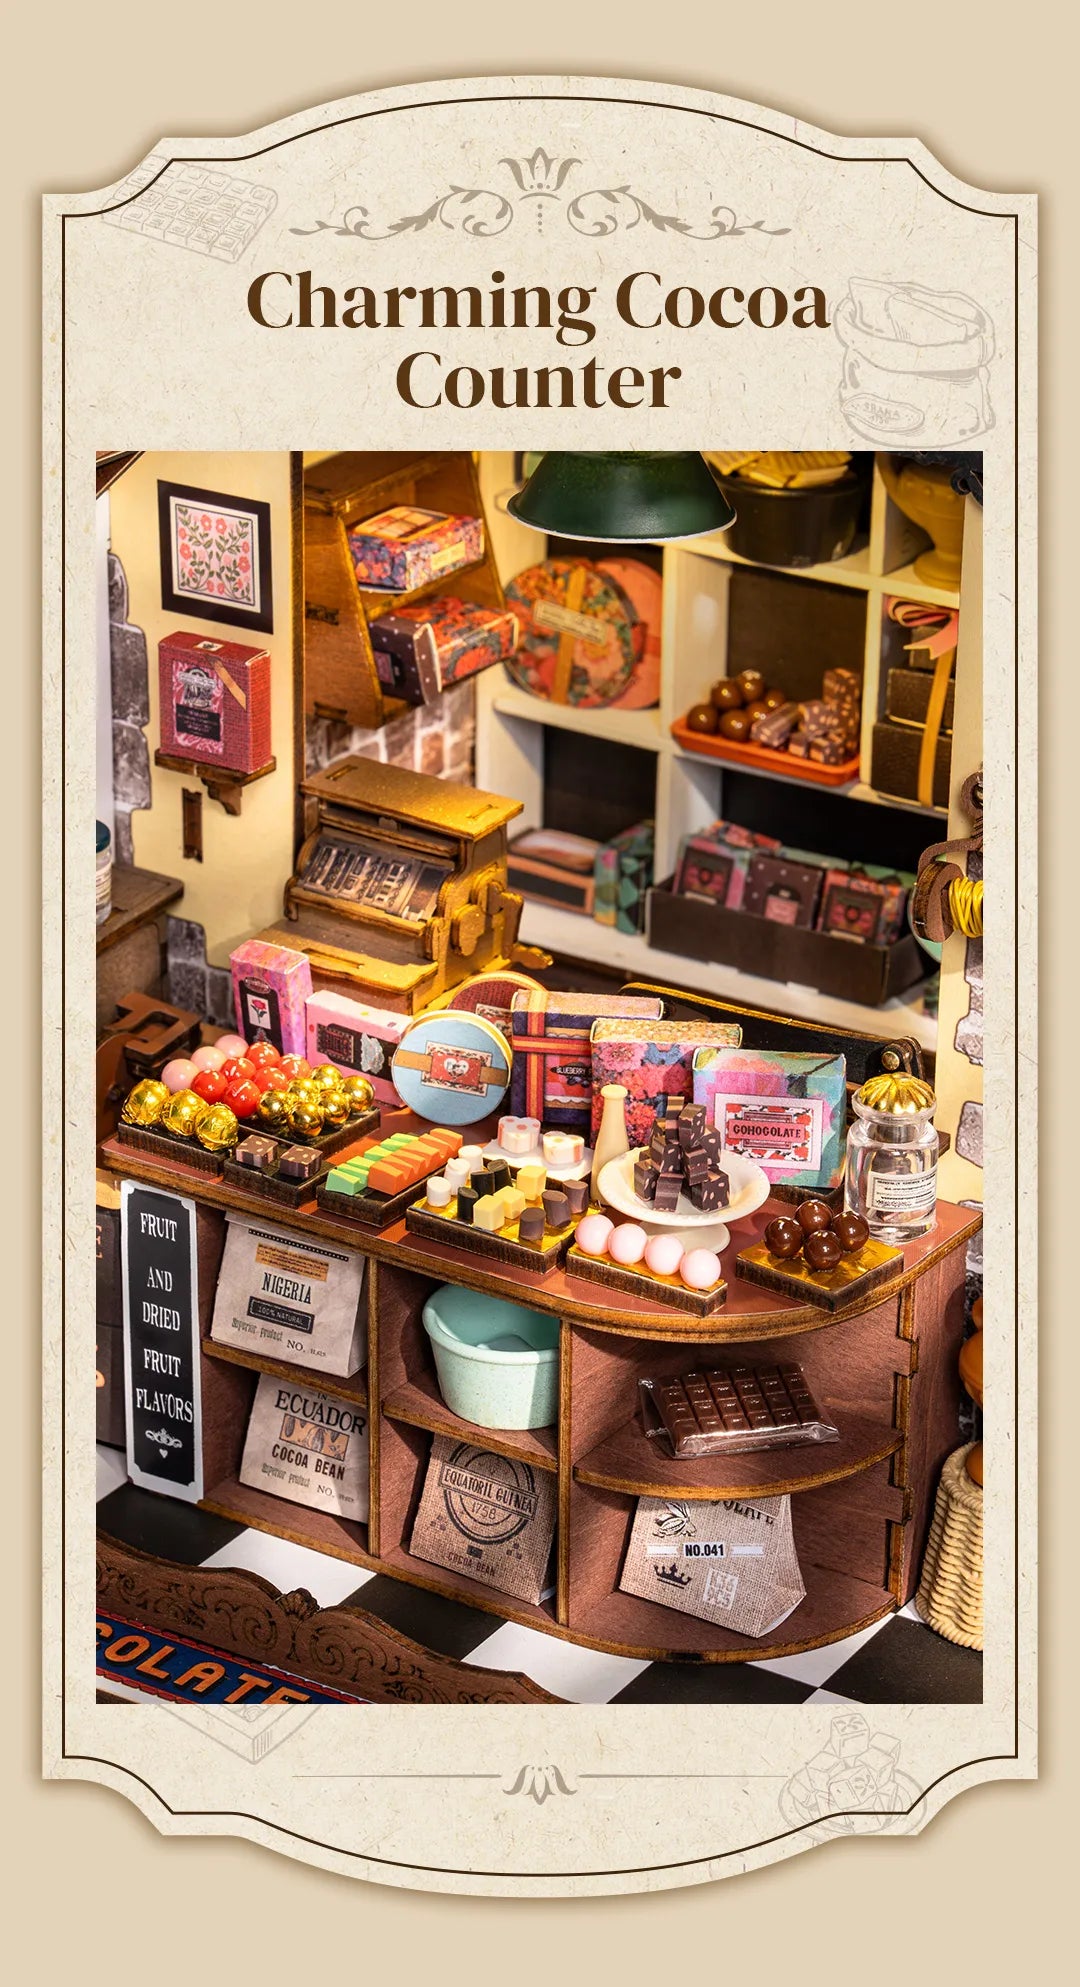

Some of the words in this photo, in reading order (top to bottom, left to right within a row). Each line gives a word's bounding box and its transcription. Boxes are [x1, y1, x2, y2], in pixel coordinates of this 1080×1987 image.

[140, 1212, 178, 1242] FRUIT
[147, 1266, 173, 1292] AND
[261, 1272, 312, 1304] NIGERIA
[142, 1301, 181, 1331] DRIED
[287, 1339, 306, 1354] NO.
[144, 1348, 182, 1378] FRUIT
[136, 1388, 193, 1424] FLAVORS
[275, 1389, 366, 1436] ECUADOR
[272, 1443, 309, 1469] COCOA
[315, 1458, 346, 1480] BEAN
[444, 1467, 493, 1498] EQUATORIL
[685, 1543, 725, 1557] NO.041
